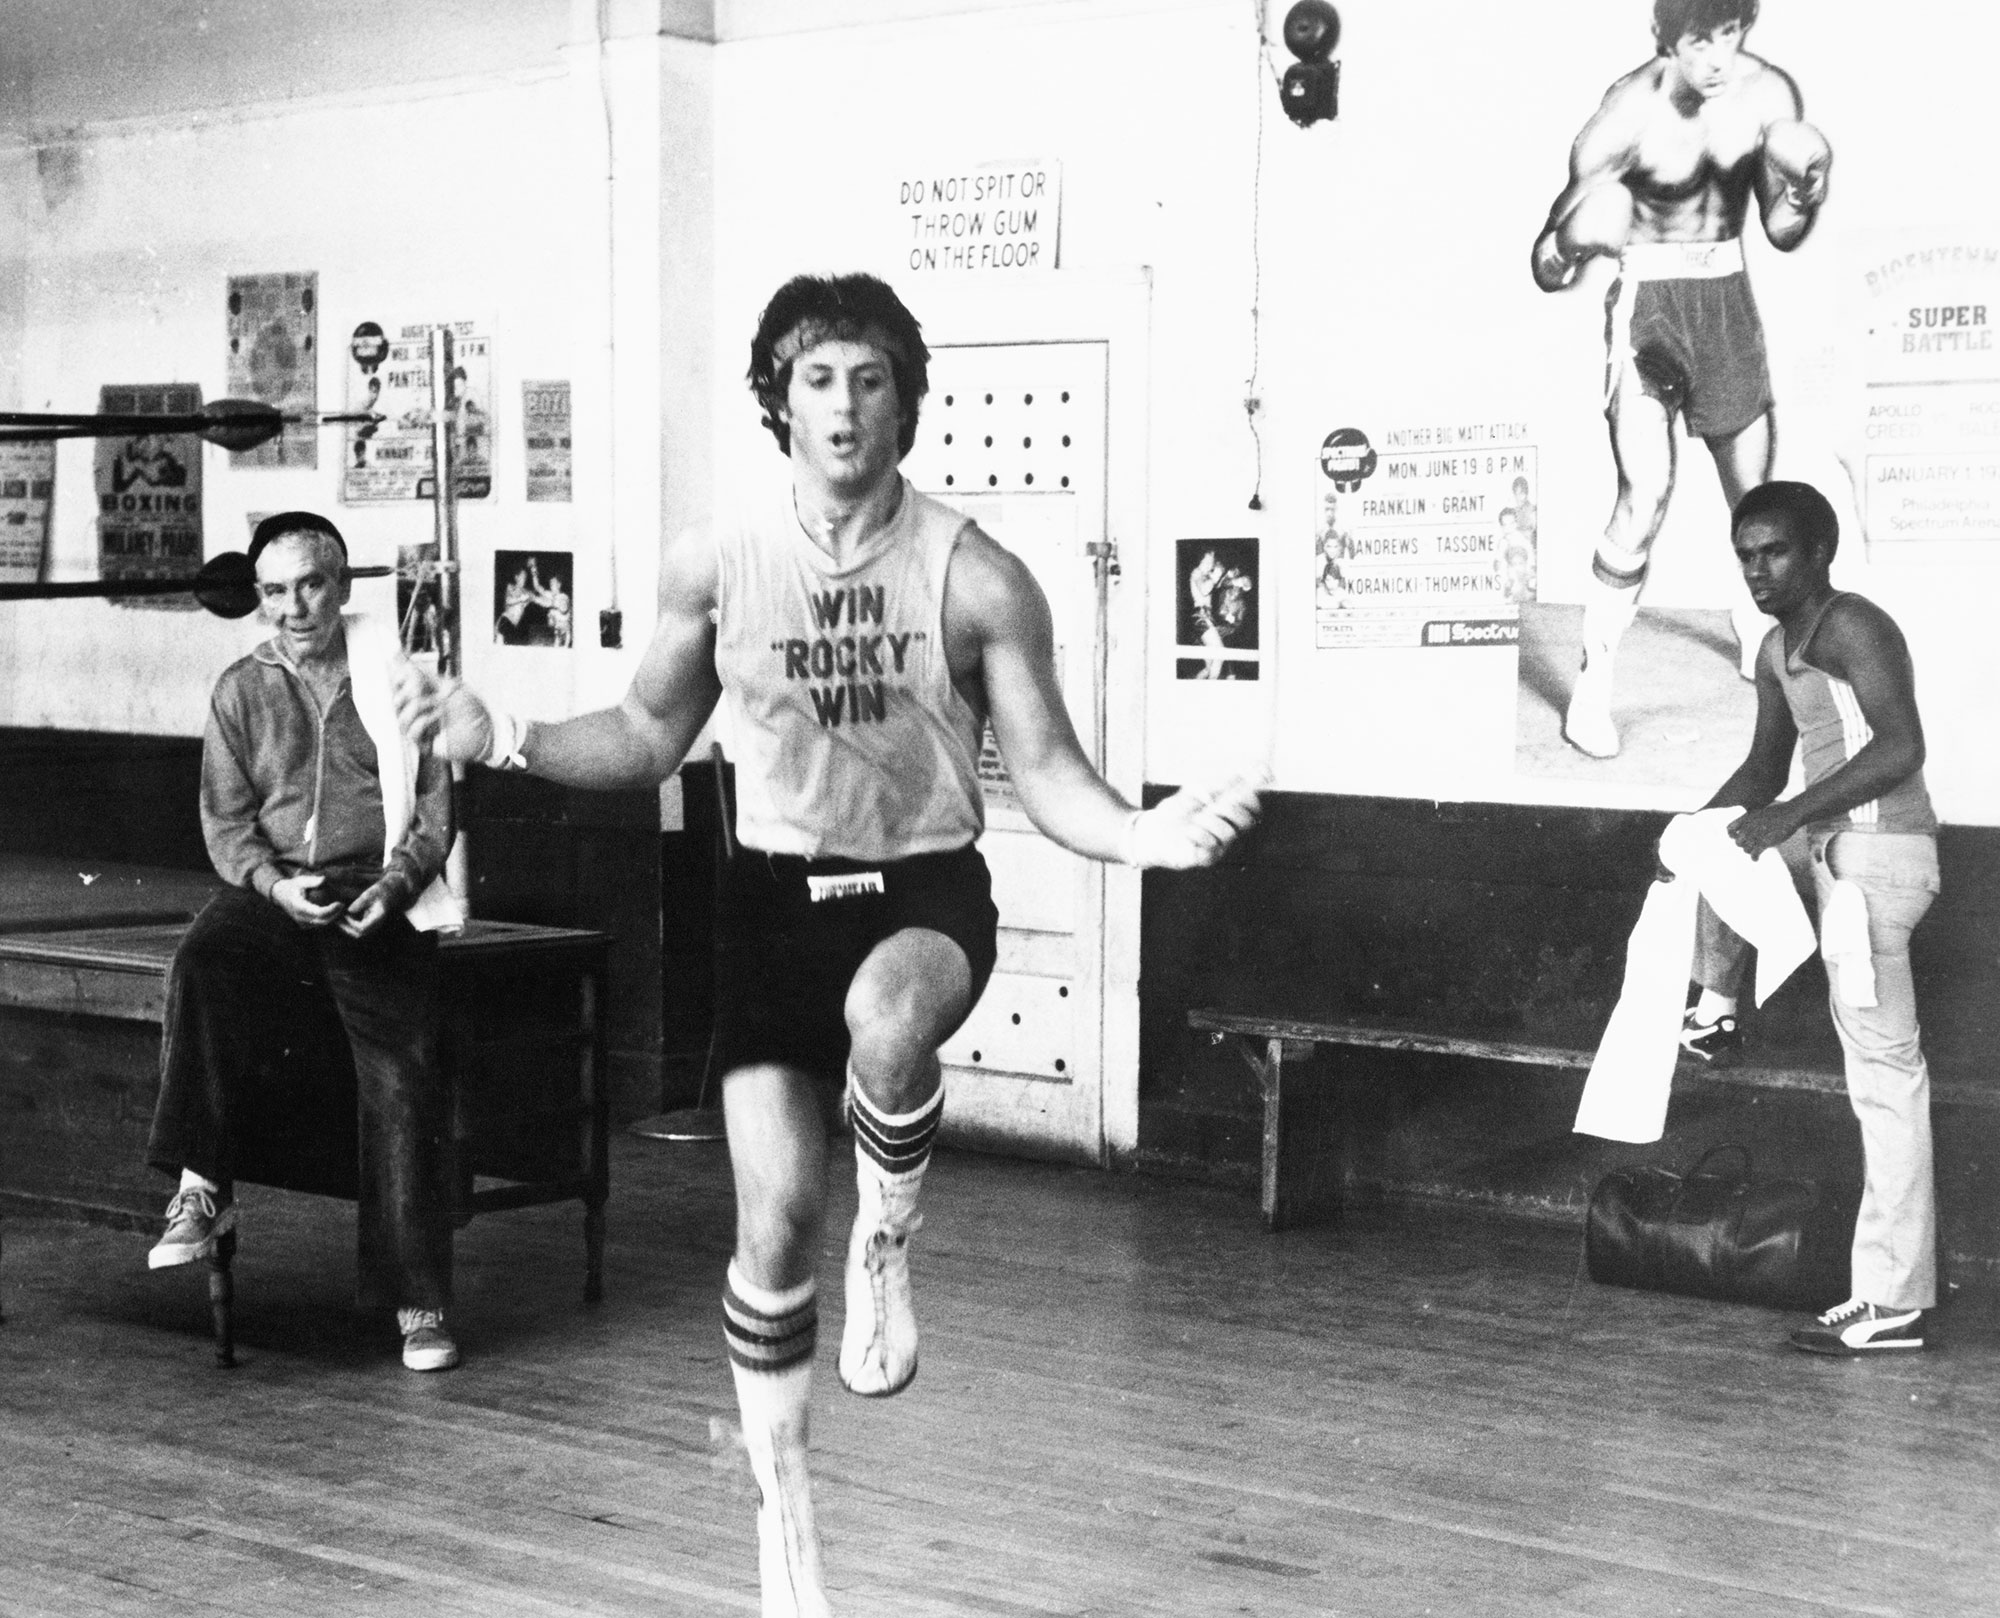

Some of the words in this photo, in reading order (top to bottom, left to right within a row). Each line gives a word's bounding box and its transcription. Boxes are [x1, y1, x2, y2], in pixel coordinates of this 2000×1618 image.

[900, 181, 925, 206] DO
[931, 176, 968, 203] NOT
[973, 173, 1015, 202] SPIT
[1020, 171, 1046, 199] OR
[911, 212, 986, 239] THROW
[993, 209, 1038, 237] GUM
[909, 248, 937, 271] ON
[944, 245, 976, 270] THE
[981, 241, 1040, 269] FLOOR
[1908, 304, 1987, 329] SUPER
[1902, 329, 1992, 354] BATTLE
[1868, 404, 1921, 418] APOLLO
[1386, 427, 1432, 447] ANOTHER
[1436, 426, 1453, 445] BIG
[1458, 424, 1485, 443] MATT
[1489, 422, 1528, 441] ATTACK
[1864, 422, 1921, 440] CREED
[1425, 458, 1458, 478] JUNE
[1462, 457, 1477, 475] 19
[1486, 456, 1494, 475] 8
[1877, 466, 1959, 484] JANUARY
[101, 493, 198, 512] BOXING
[1362, 498, 1426, 517] FRANKLIN
[1442, 494, 1486, 514] GRANT
[1901, 496, 1990, 513] Philadelphia
[1889, 515, 1959, 531] Spectrum
[1355, 537, 1419, 556] ANDREWS
[1436, 534, 1494, 553] TASSONE
[1348, 576, 1418, 596] KORANICKI
[1424, 574, 1502, 593] THOMPKINS
[812, 584, 885, 629] WIN
[771, 631, 926, 679] "ROCKY"
[810, 679, 887, 727] WIN
